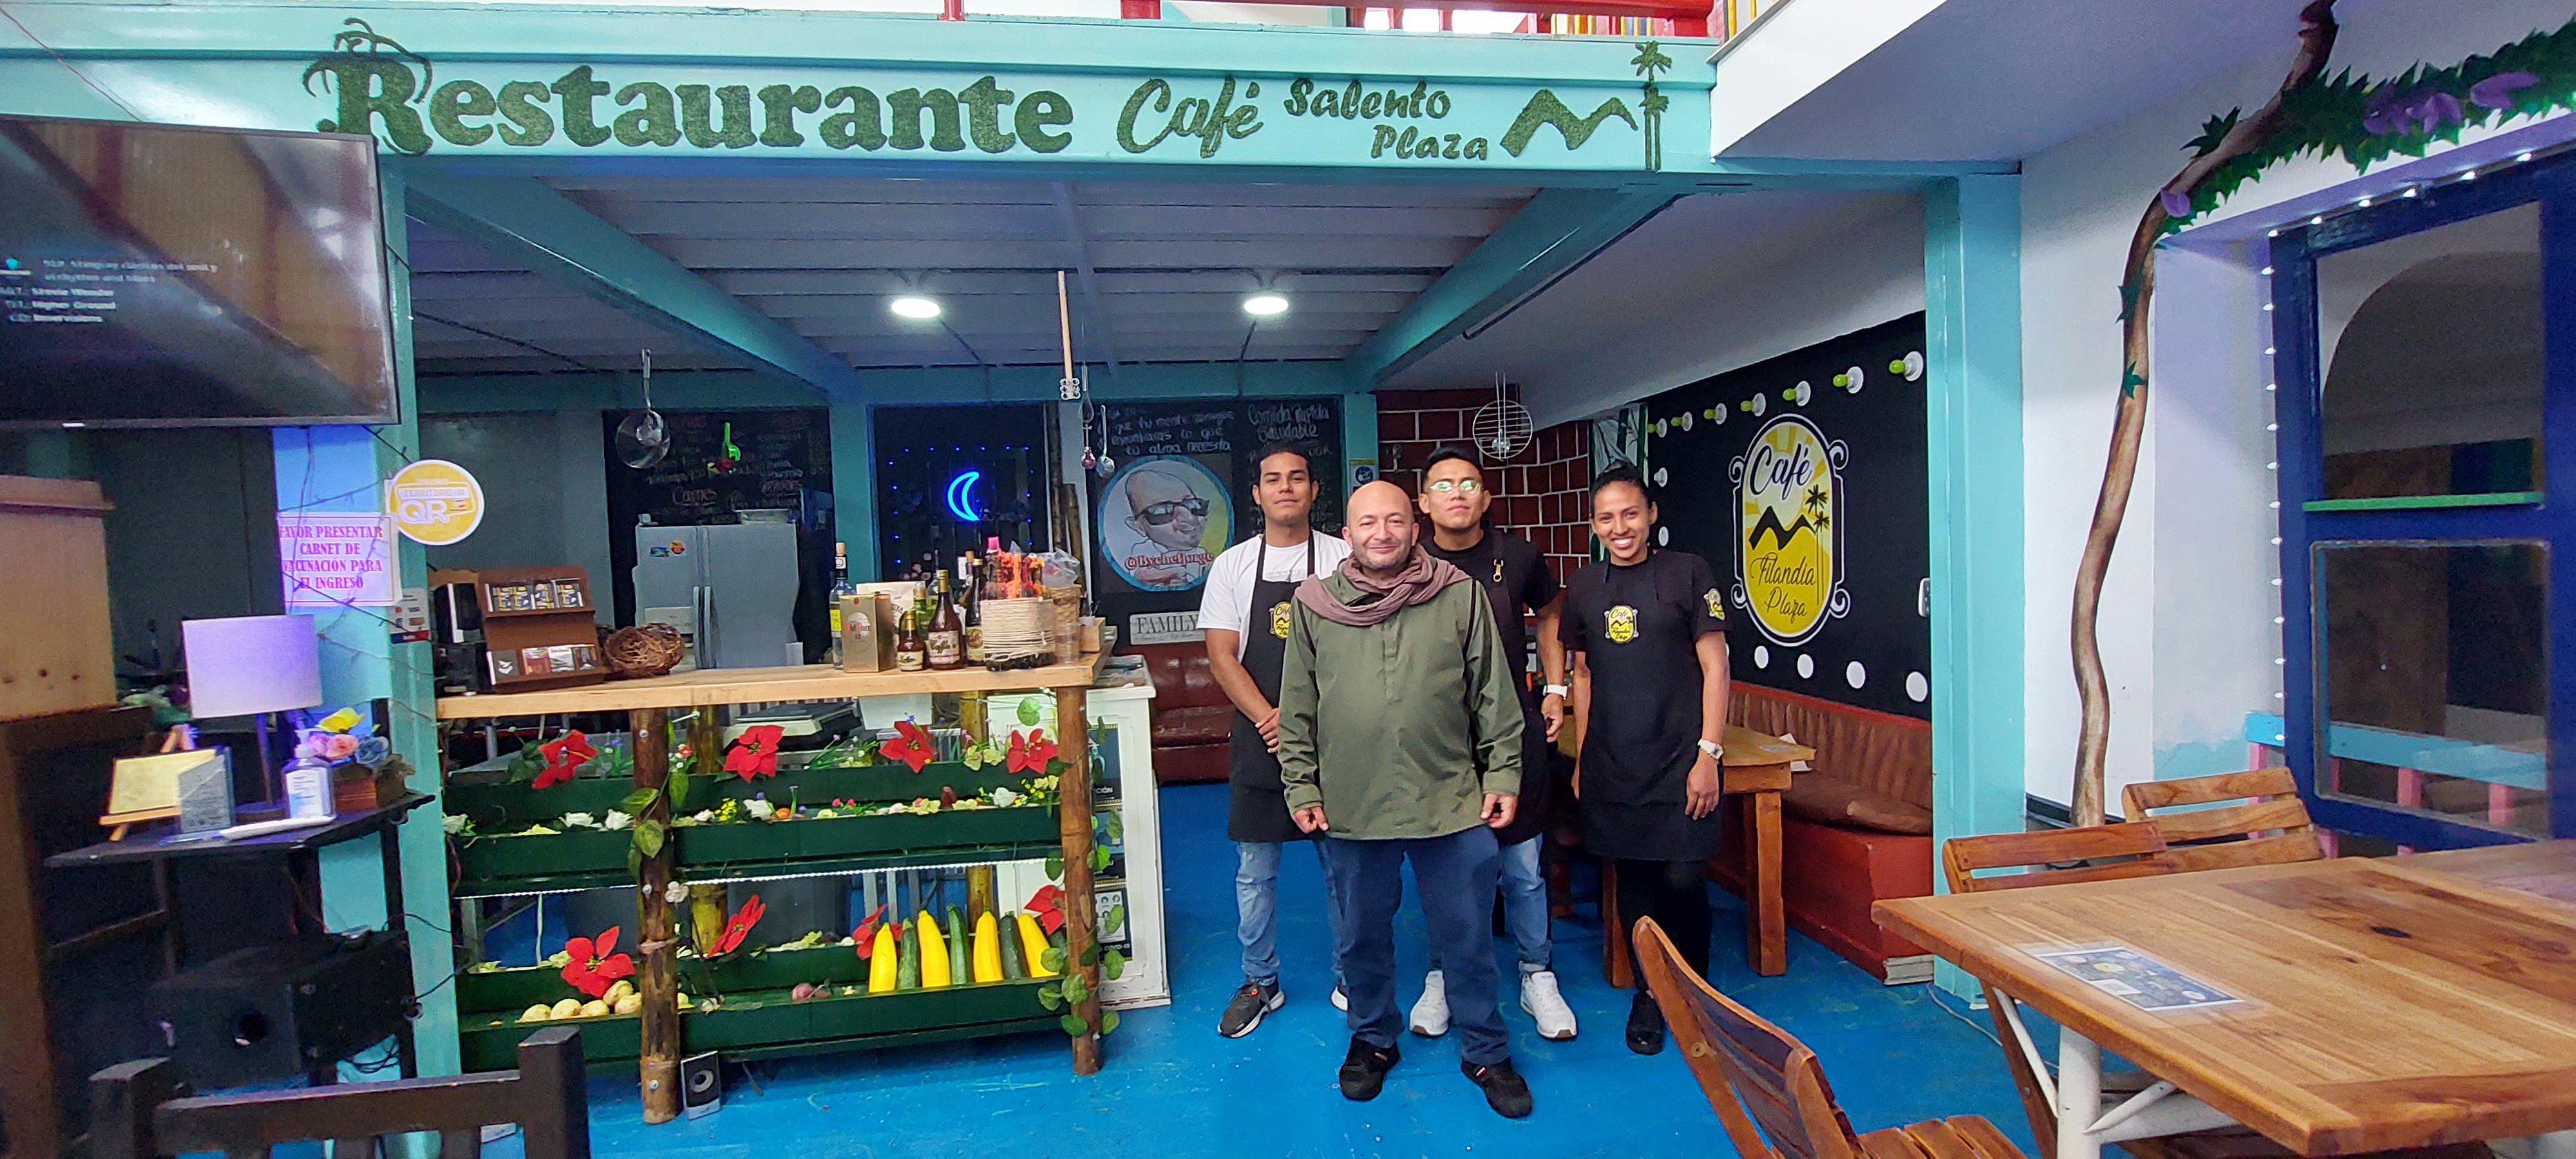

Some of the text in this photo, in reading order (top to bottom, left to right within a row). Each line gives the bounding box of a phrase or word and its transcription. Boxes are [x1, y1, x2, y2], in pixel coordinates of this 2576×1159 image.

[303, 39, 1264, 158] Restaurante Café
[1283, 77, 1452, 120] Salento
[1370, 124, 1488, 160] Plaza
[1749, 442, 1813, 501] Café
[399, 499, 450, 524] QR
[316, 525, 383, 538] PRESENTAR
[300, 542, 361, 555] CARNET DE
[350, 560, 383, 572] PARA
[300, 576, 364, 589] EL INGRESO
[1763, 586, 1808, 625] Plaza
[1137, 614, 1199, 634] FAMILY
